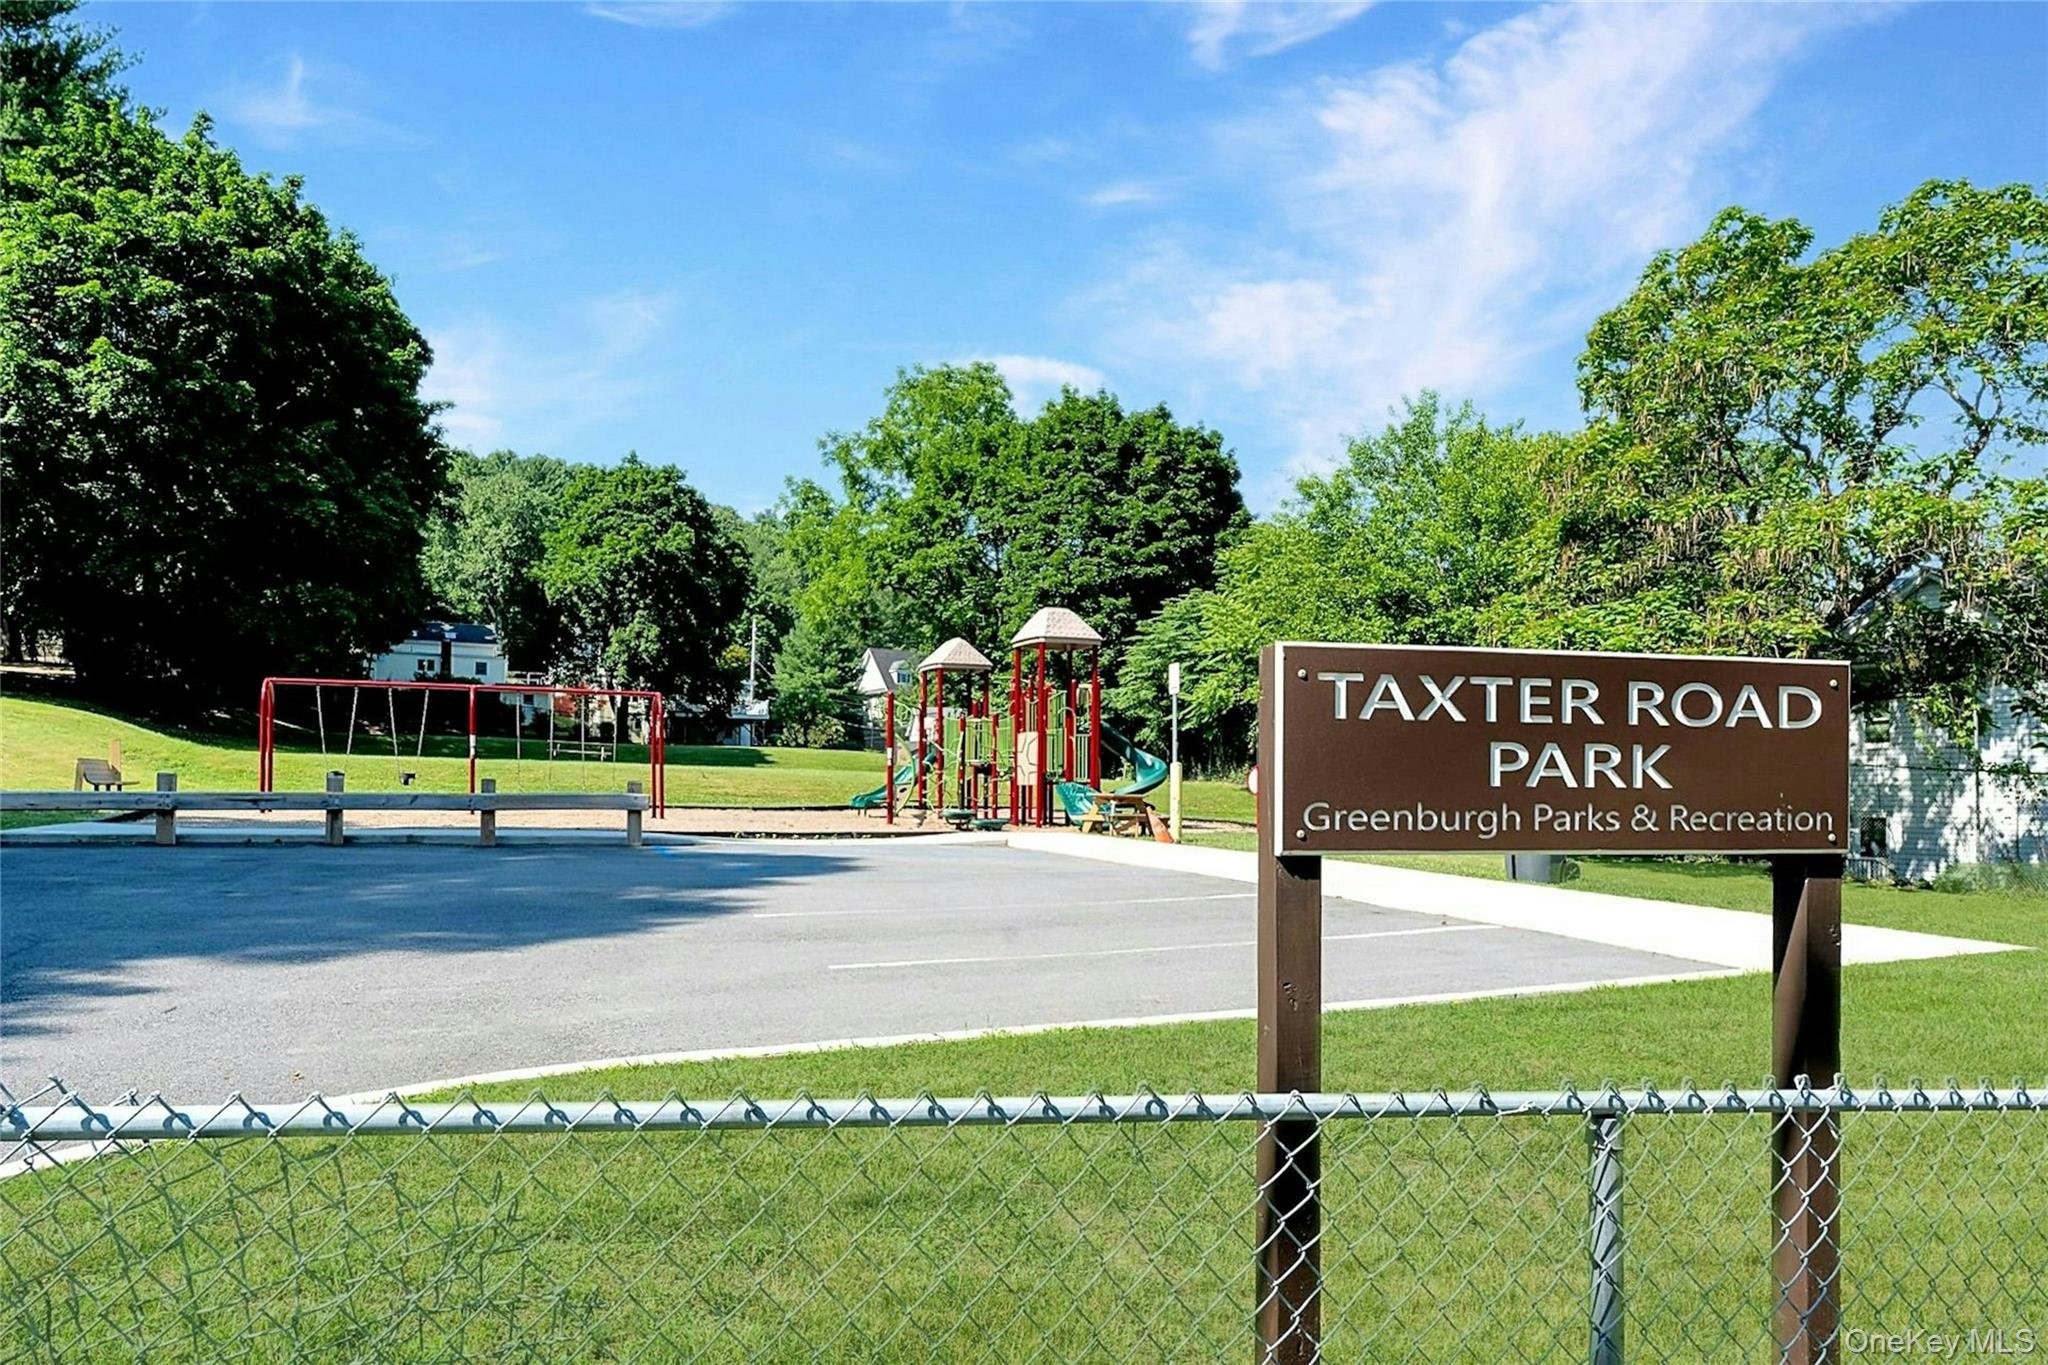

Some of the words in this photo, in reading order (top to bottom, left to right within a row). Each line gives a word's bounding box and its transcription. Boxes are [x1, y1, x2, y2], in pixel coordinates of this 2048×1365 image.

[1317, 671, 1605, 726] TAXTER
[1627, 680, 1823, 730] ROAD
[1489, 741, 1673, 790] PARK
[1303, 802, 1521, 840] Greenburgh
[1533, 803, 1621, 832] Parks
[1630, 804, 1659, 832] &
[1670, 804, 1834, 833] Recreation
